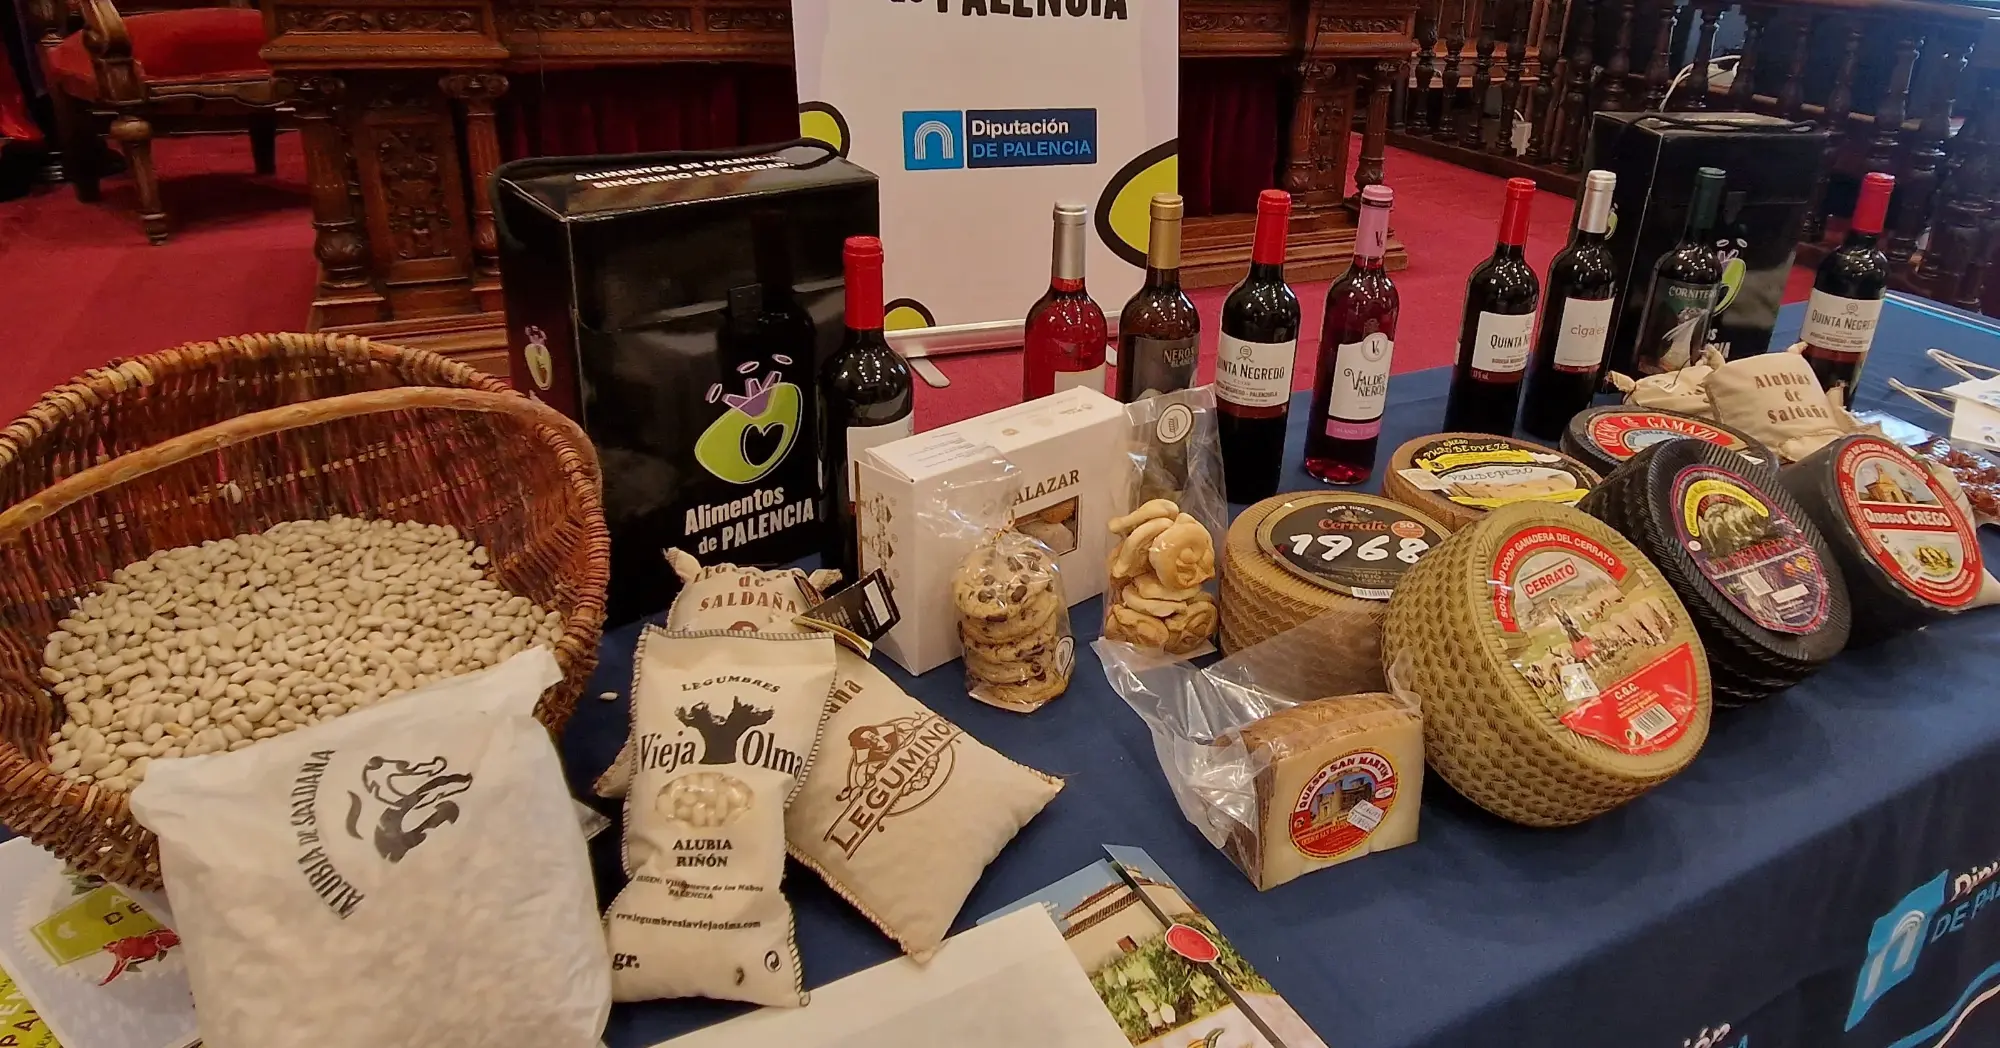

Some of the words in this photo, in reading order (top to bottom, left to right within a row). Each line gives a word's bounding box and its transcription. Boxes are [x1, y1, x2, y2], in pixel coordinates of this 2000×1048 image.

[971, 118, 1069, 138] Diputación
[972, 143, 998, 158] DE
[1003, 140, 1091, 157] PALENCIA
[575, 165, 678, 181] ALIMENTOS
[694, 169, 719, 177] DE
[1811, 309, 1841, 327] QUINTA
[1490, 334, 1521, 349] QUINTA
[1240, 363, 1285, 380] NEGREDO
[1784, 389, 1803, 402] de
[1647, 417, 1719, 440] GAMAZO
[1012, 469, 1080, 506] ALAZAR
[685, 486, 785, 535] Alimentos
[1863, 508, 1908, 525] Quesos
[1906, 510, 1952, 527] CREGO
[698, 536, 718, 555] de
[722, 498, 814, 550] PALENCIA
[1318, 518, 1388, 532] Cerrato
[1289, 533, 1430, 564] 1968
[1515, 532, 1556, 551] GANADERA
[1556, 532, 1573, 544] DEL
[1574, 538, 1615, 566] CERRATO
[738, 575, 765, 587] de
[1524, 564, 1576, 596] CERRATO
[698, 591, 798, 614] SALDAÑA
[681, 675, 782, 693] LEGUMBRES
[640, 730, 696, 773] Vieja
[742, 729, 803, 781] Olma
[1299, 769, 1328, 809] QUESO
[1329, 757, 1356, 773] SAN
[297, 828, 320, 846] DE
[672, 839, 733, 851] ALUBIA
[676, 853, 729, 868] RIÑÓN
[297, 846, 365, 920] ALUBIA
[668, 889, 714, 900] PALENCIA
[1930, 901, 1970, 944] DE
[612, 953, 641, 971] gr.
